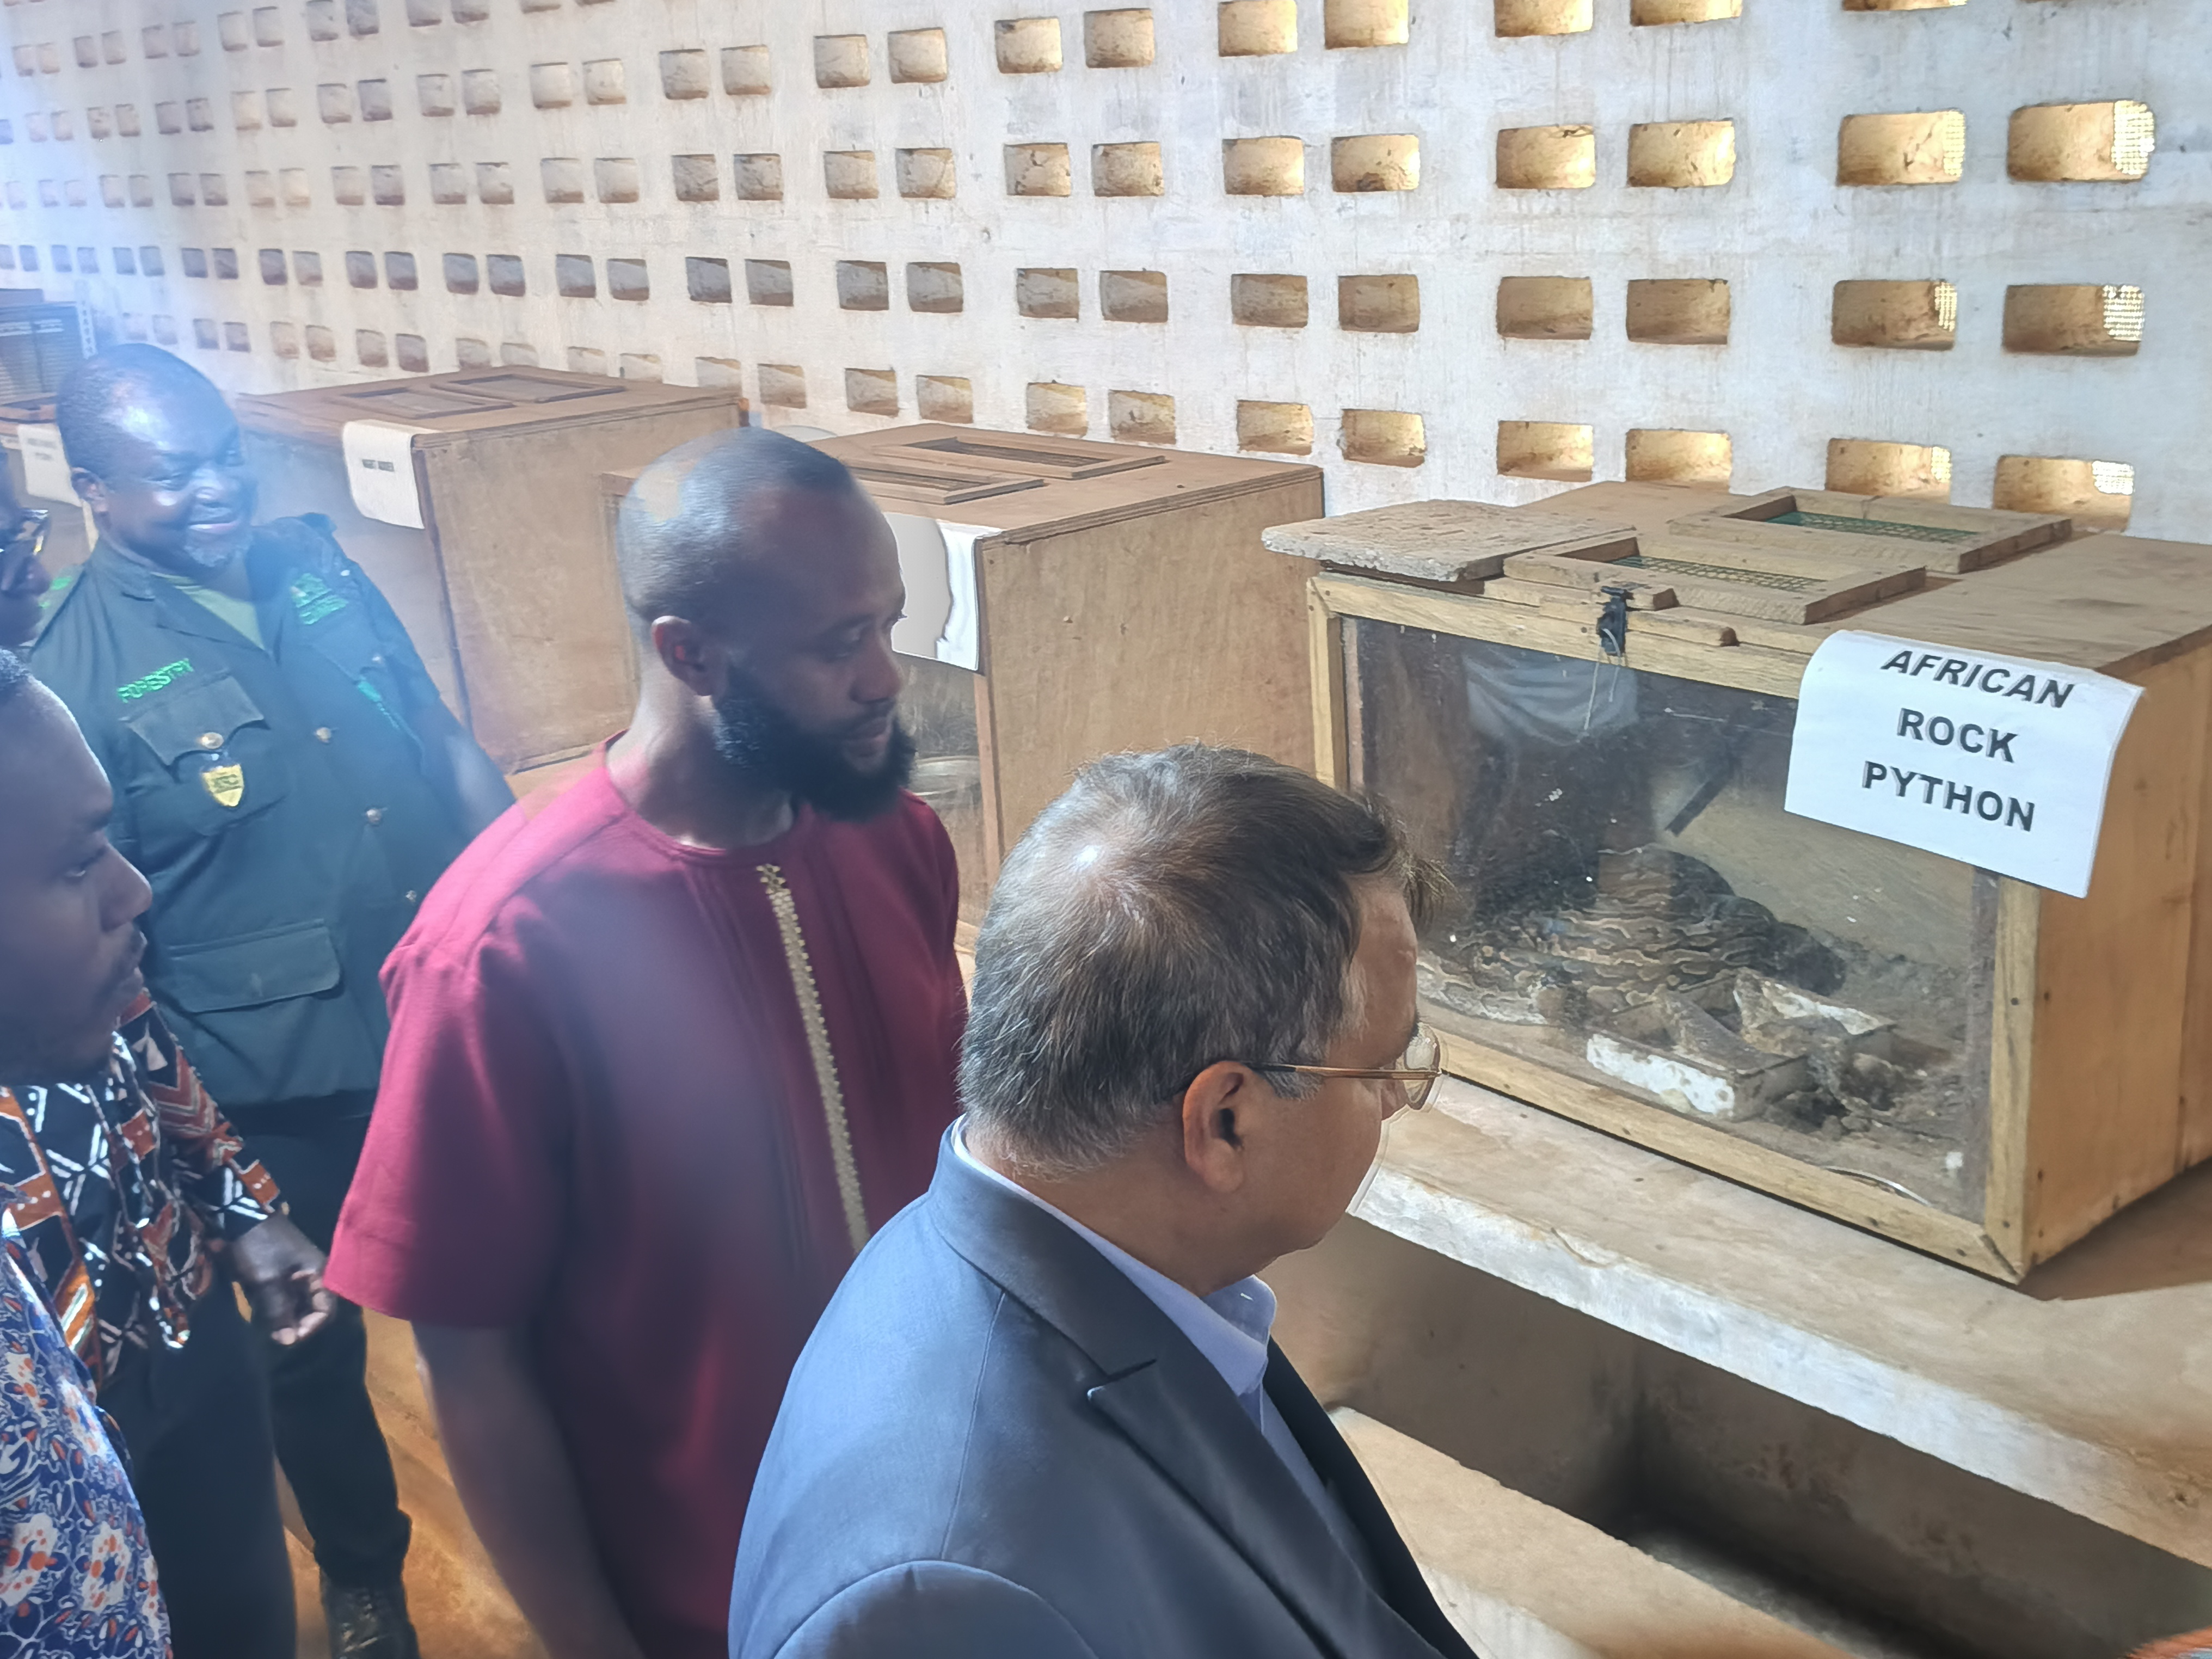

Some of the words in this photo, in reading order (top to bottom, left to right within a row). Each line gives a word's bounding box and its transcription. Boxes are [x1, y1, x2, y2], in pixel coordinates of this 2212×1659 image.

[1880, 650, 2074, 708] AFRICAN
[1897, 708, 2018, 763] ROCK
[1861, 760, 2035, 832] PYTHON
